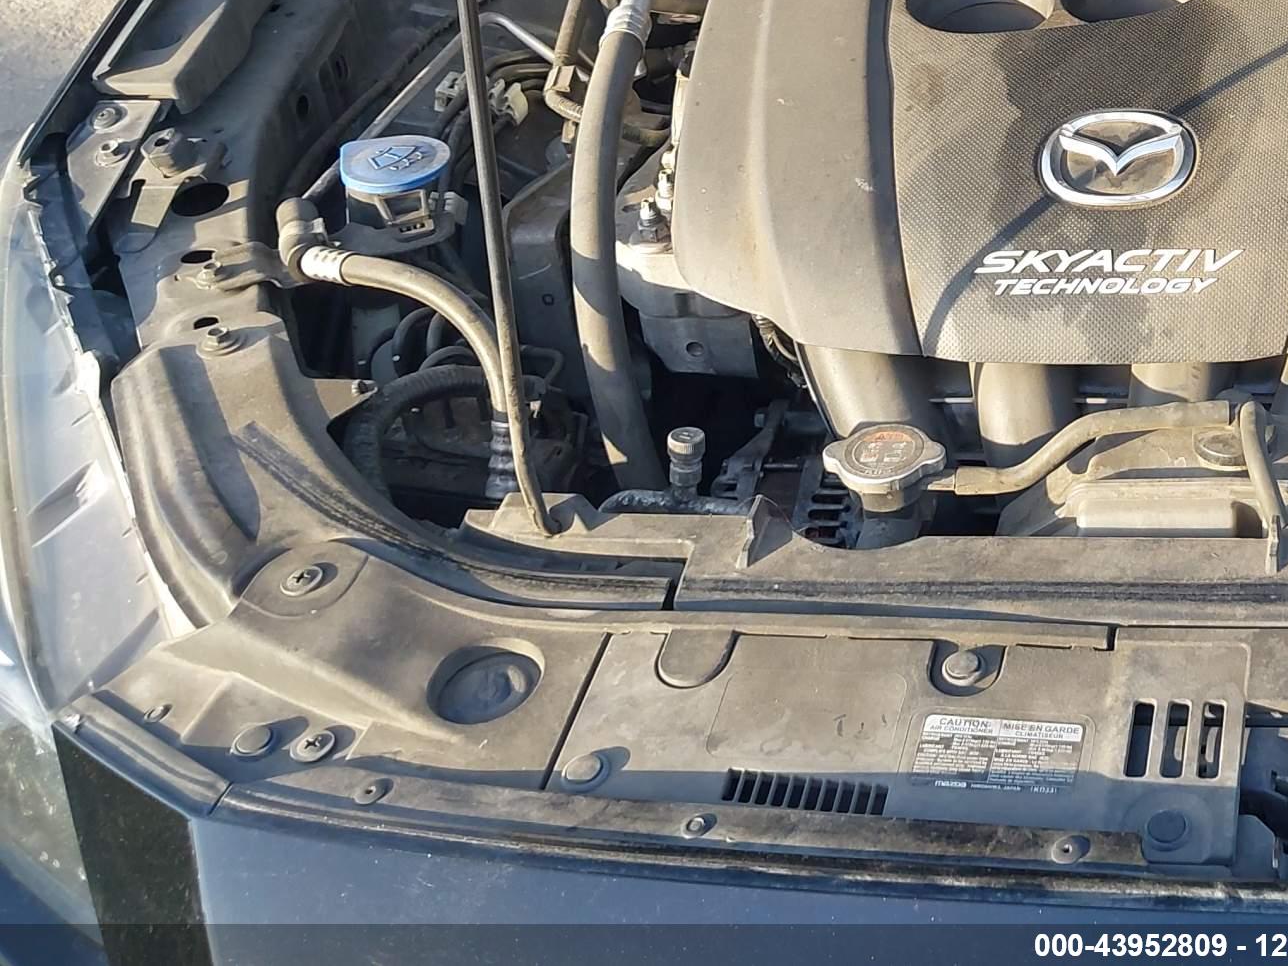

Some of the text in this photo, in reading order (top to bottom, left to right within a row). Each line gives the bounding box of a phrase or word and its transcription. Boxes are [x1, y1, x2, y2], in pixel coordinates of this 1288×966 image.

[974, 249, 1243, 274] SKYACTIV
[993, 277, 1218, 296] TECHNOLOGY
[944, 725, 993, 734] CONDITIONER
[1045, 726, 1080, 735] GARDE
[1014, 731, 1064, 739] CLIMATISEUR
[935, 780, 967, 789] mazda
